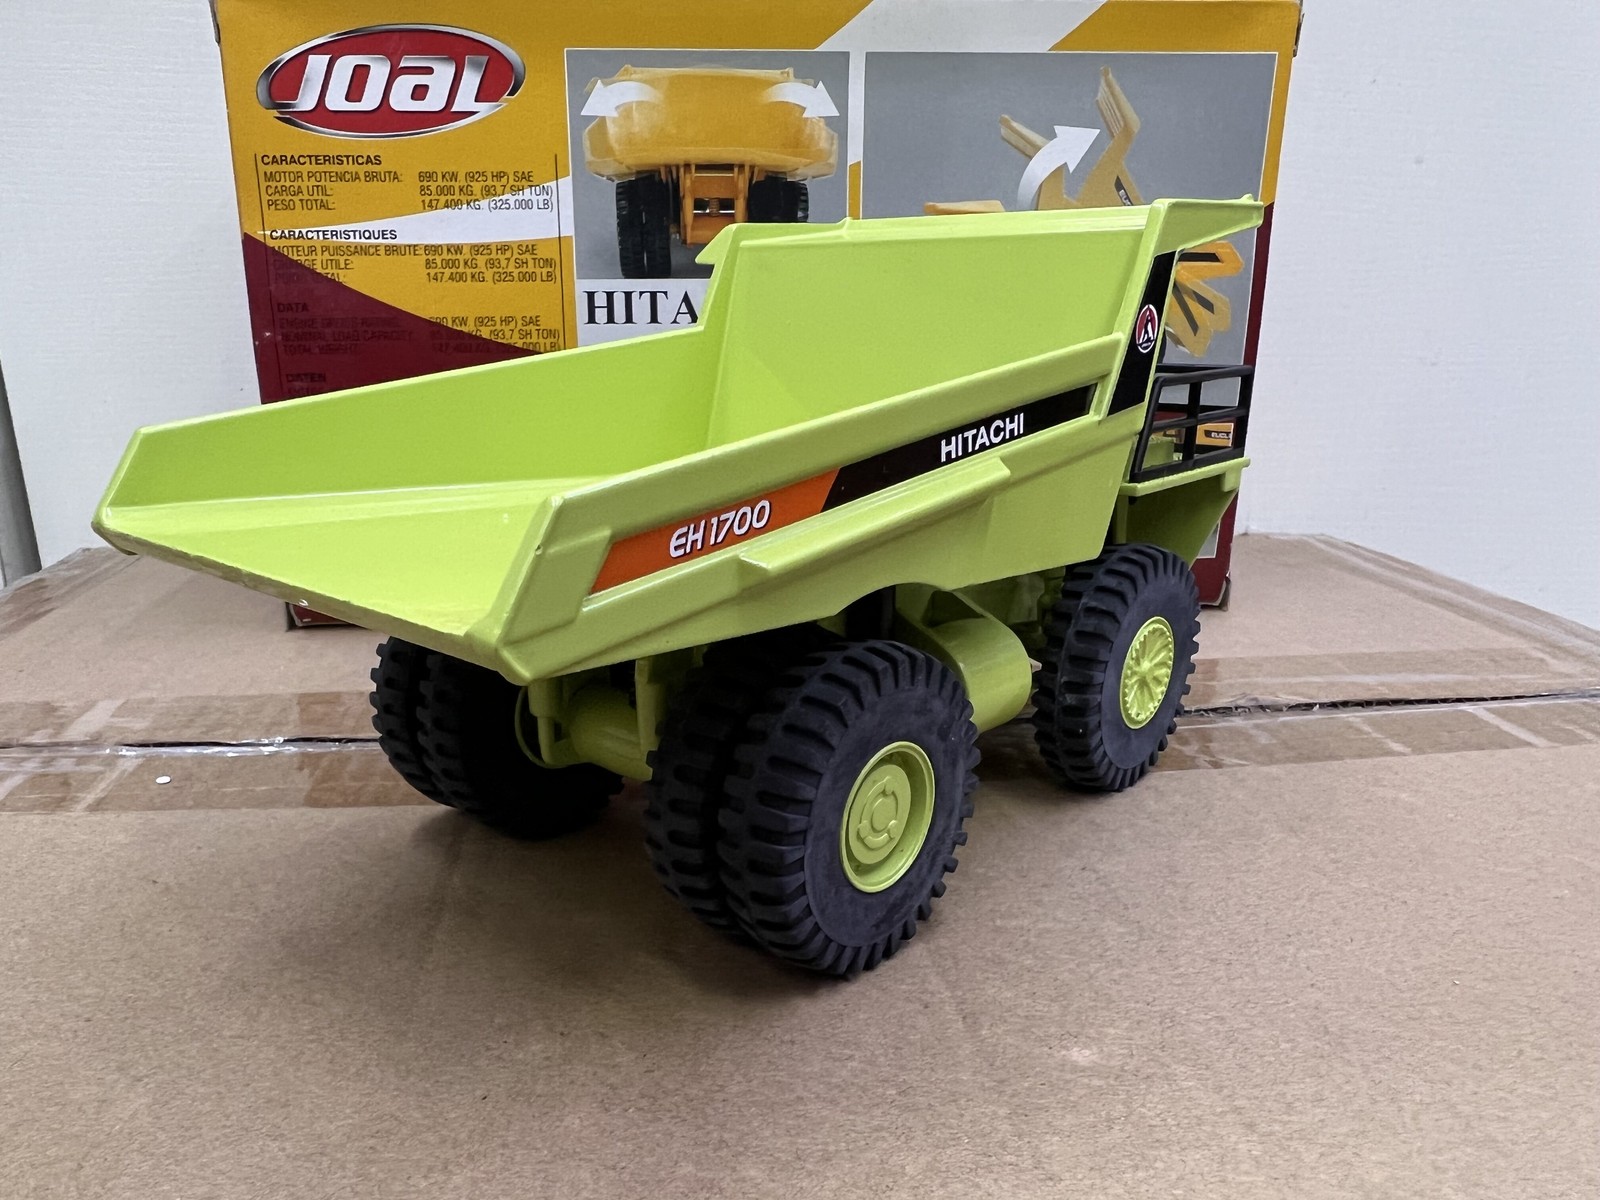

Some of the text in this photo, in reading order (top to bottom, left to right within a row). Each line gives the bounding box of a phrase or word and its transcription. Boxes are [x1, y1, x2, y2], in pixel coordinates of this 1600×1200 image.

[261, 154, 382, 166] CARACTERISTICAS
[264, 170, 304, 183] MOTOR
[307, 170, 361, 183] POTENCIA
[364, 170, 403, 183] BRUTA:
[418, 171, 438, 182] 690
[465, 171, 488, 184] (925
[491, 171, 510, 185] HP)
[513, 171, 534, 182] SAE
[265, 185, 304, 197] CARGA
[419, 185, 455, 197] 85.000
[509, 185, 525, 196] SH
[529, 184, 554, 199] TON)
[267, 199, 296, 210] PESO
[299, 199, 336, 210] TOTAL:
[488, 198, 534, 212] (325.000
[536, 198, 554, 212] LB)
[269, 230, 398, 240] CARACTERISTIQUES
[320, 244, 381, 257] PUISSANCE
[423, 244, 443, 256] 690
[469, 244, 493, 257] (925
[495, 244, 514, 258] HP)
[517, 244, 538, 256] SAE
[425, 258, 460, 270] 85.000
[513, 257, 529, 269] SH
[532, 257, 557, 271] TON)
[492, 271, 537, 285] (325.000
[540, 271, 557, 284] LB)
[582, 290, 699, 325] HITA
[474, 316, 497, 329] (925
[500, 316, 518, 329] HP)
[521, 315, 541, 327] SAE
[518, 329, 532, 340] SH
[535, 328, 560, 341] TON)
[941, 412, 1024, 462] HITACHI
[669, 500, 771, 558] EH 1700
